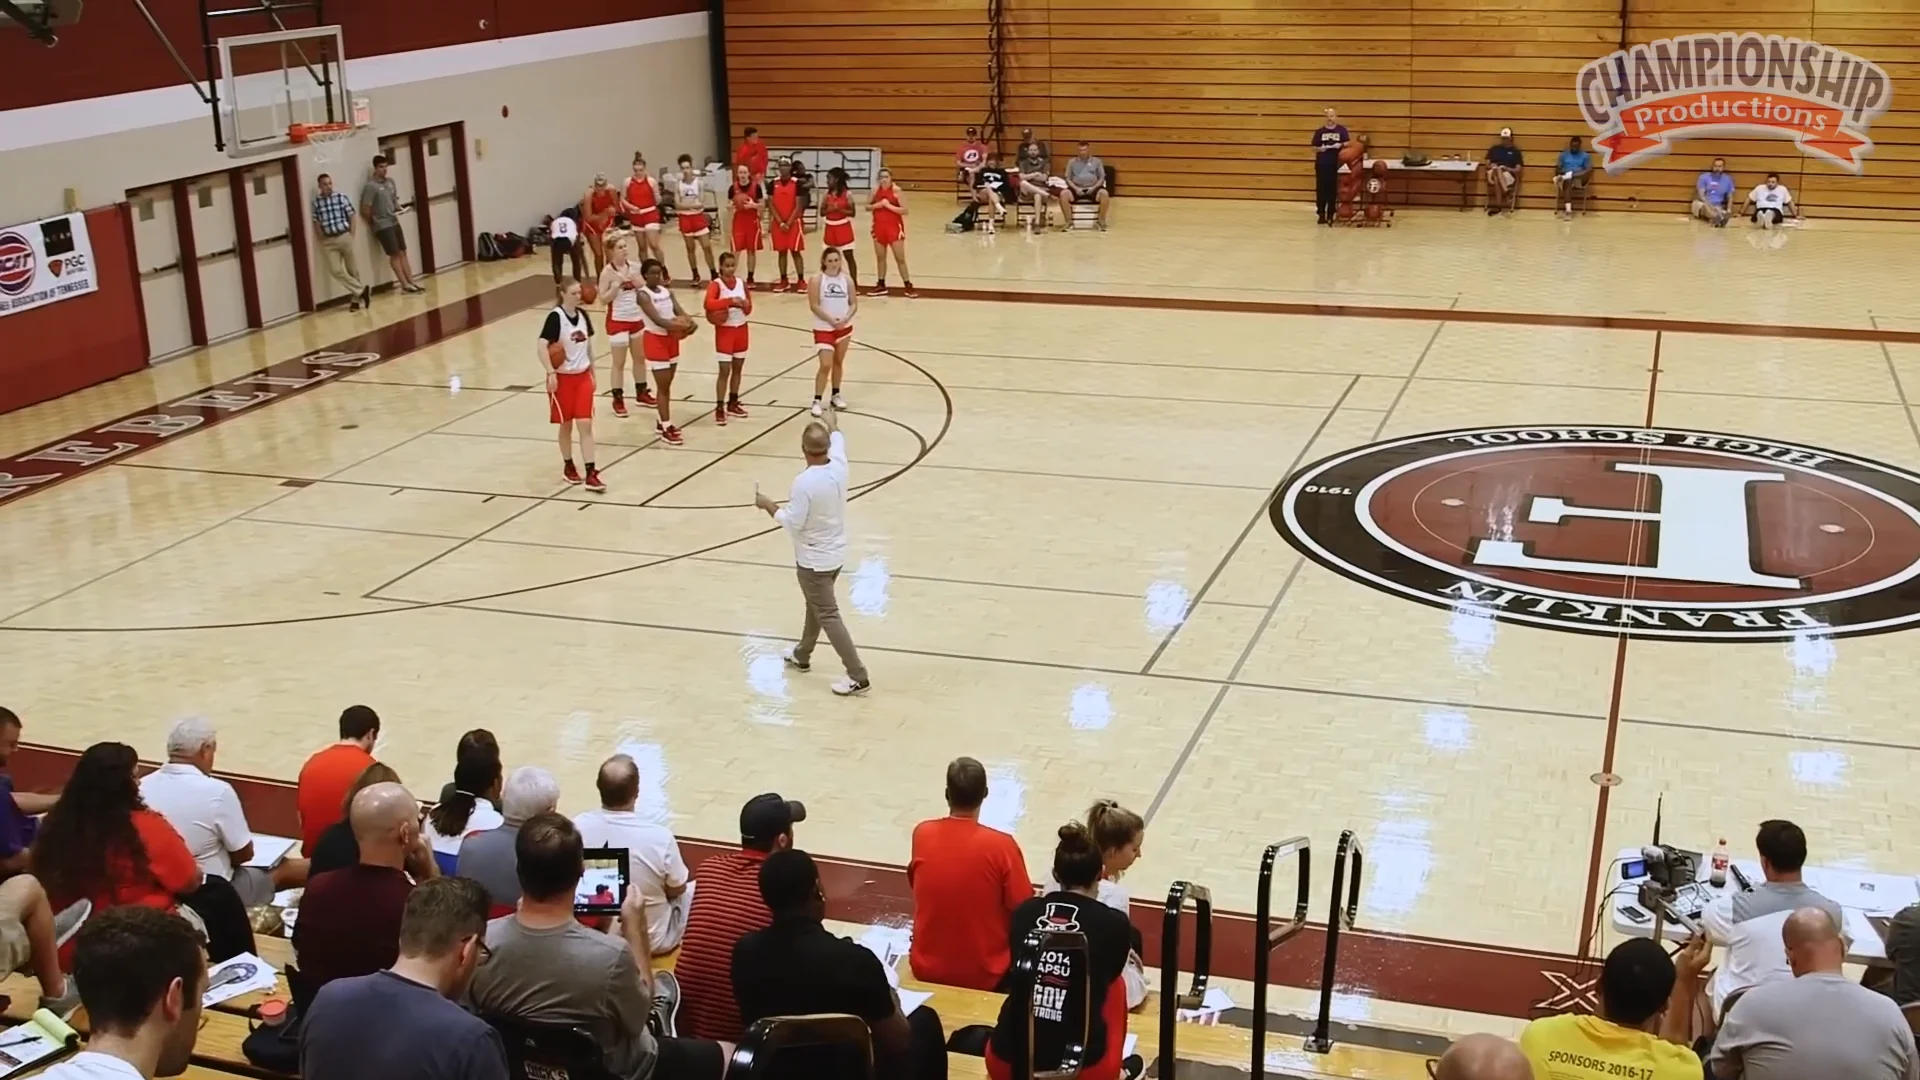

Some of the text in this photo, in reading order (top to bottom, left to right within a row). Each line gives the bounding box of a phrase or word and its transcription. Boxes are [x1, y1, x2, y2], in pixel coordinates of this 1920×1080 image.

[64, 254, 86, 269] PGC
[1447, 430, 1835, 468] HIGH SCHOOL
[1304, 485, 1353, 495] 1910
[1437, 580, 1829, 630] FRANKLIN
[1040, 951, 1071, 967] 2014
[1037, 962, 1071, 977] APSU
[1033, 984, 1067, 1009] GOV
[1548, 1050, 1606, 1072] SPONSORS
[1607, 1062, 1654, 1080] 2016-17
